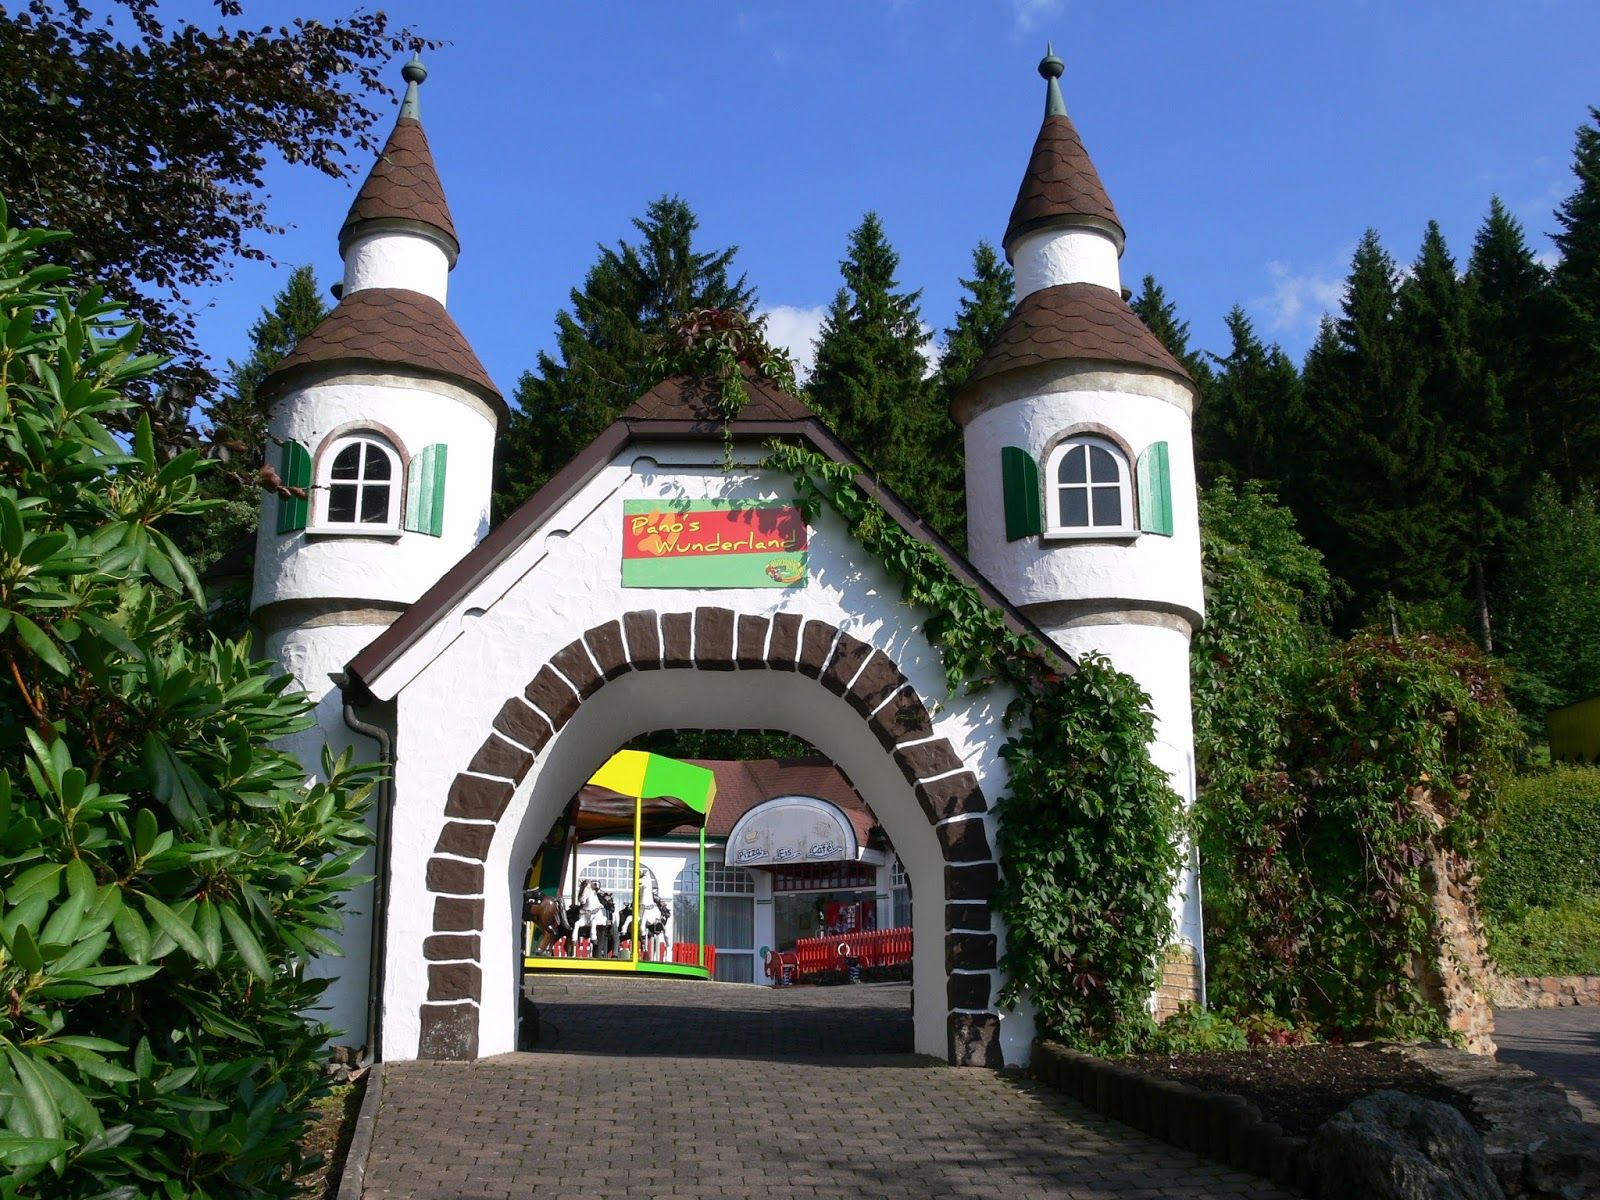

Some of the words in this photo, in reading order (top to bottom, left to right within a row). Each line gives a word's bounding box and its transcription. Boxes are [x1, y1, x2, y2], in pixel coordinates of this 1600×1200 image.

[631, 514, 700, 534] Pano's
[655, 530, 796, 553] Wunderland
[737, 847, 763, 860] Pizza
[777, 847, 793, 859] Eis
